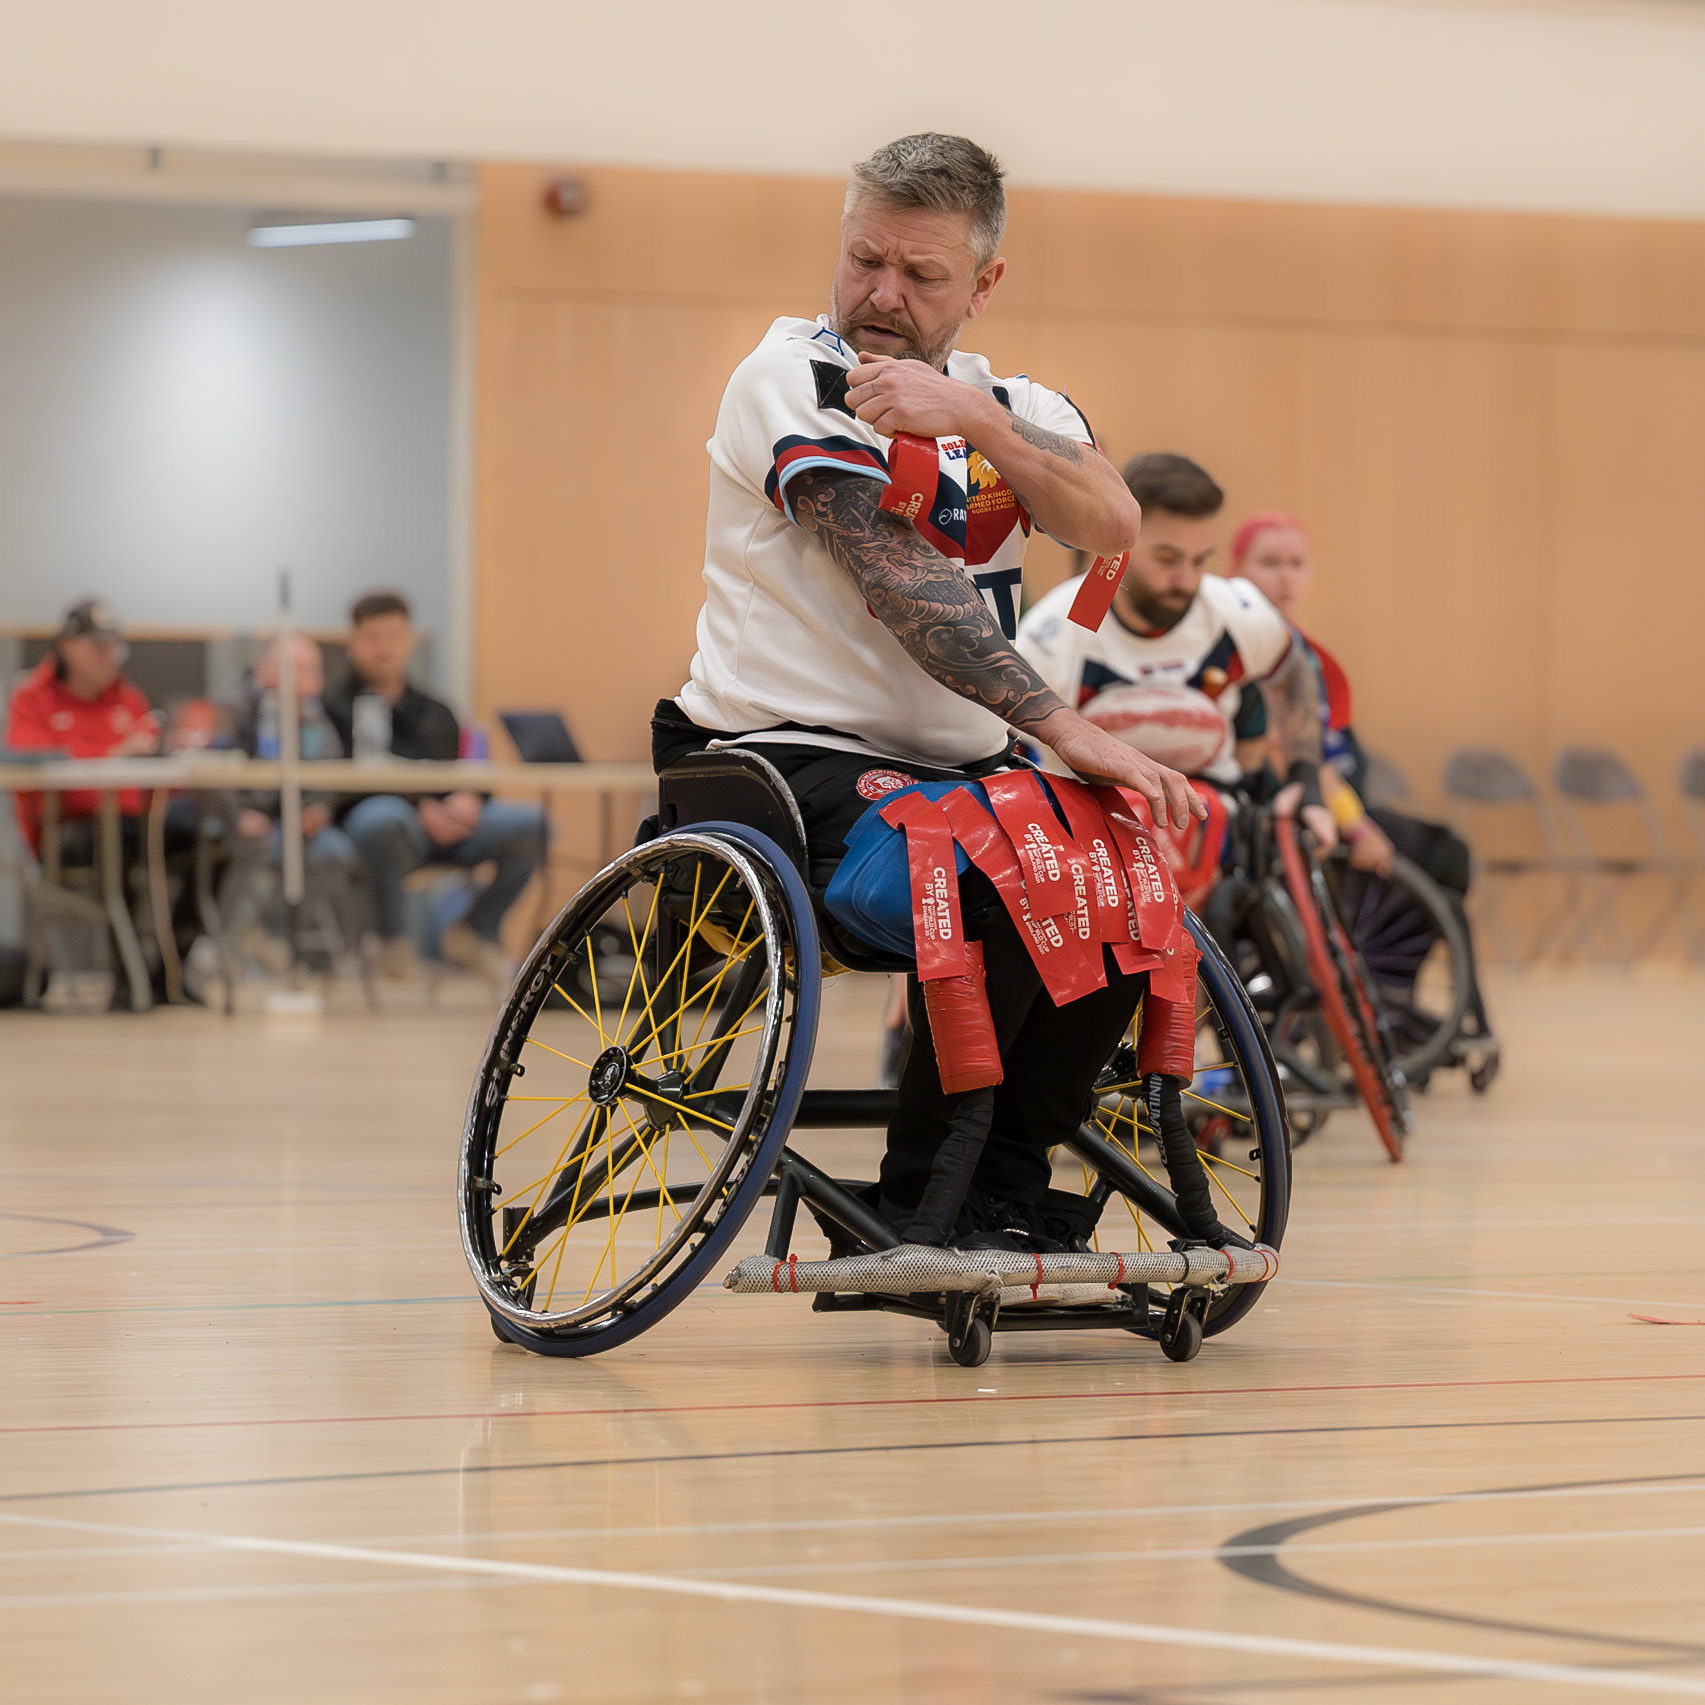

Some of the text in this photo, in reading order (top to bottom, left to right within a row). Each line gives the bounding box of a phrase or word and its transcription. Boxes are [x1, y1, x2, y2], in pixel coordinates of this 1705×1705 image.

[966, 488, 1013, 503] ITED KINGD
[992, 495, 1015, 506] FORC
[1027, 823, 1061, 882] CREATED
[1089, 851, 1099, 864] BY
[1132, 849, 1143, 861] BY
[1092, 838, 1119, 907] CREATED
[1135, 836, 1165, 903] CREATED
[925, 883, 934, 896] BY
[933, 867, 952, 940] CREATED
[1019, 897, 1031, 910] BY
[1071, 864, 1090, 940] CREATED
